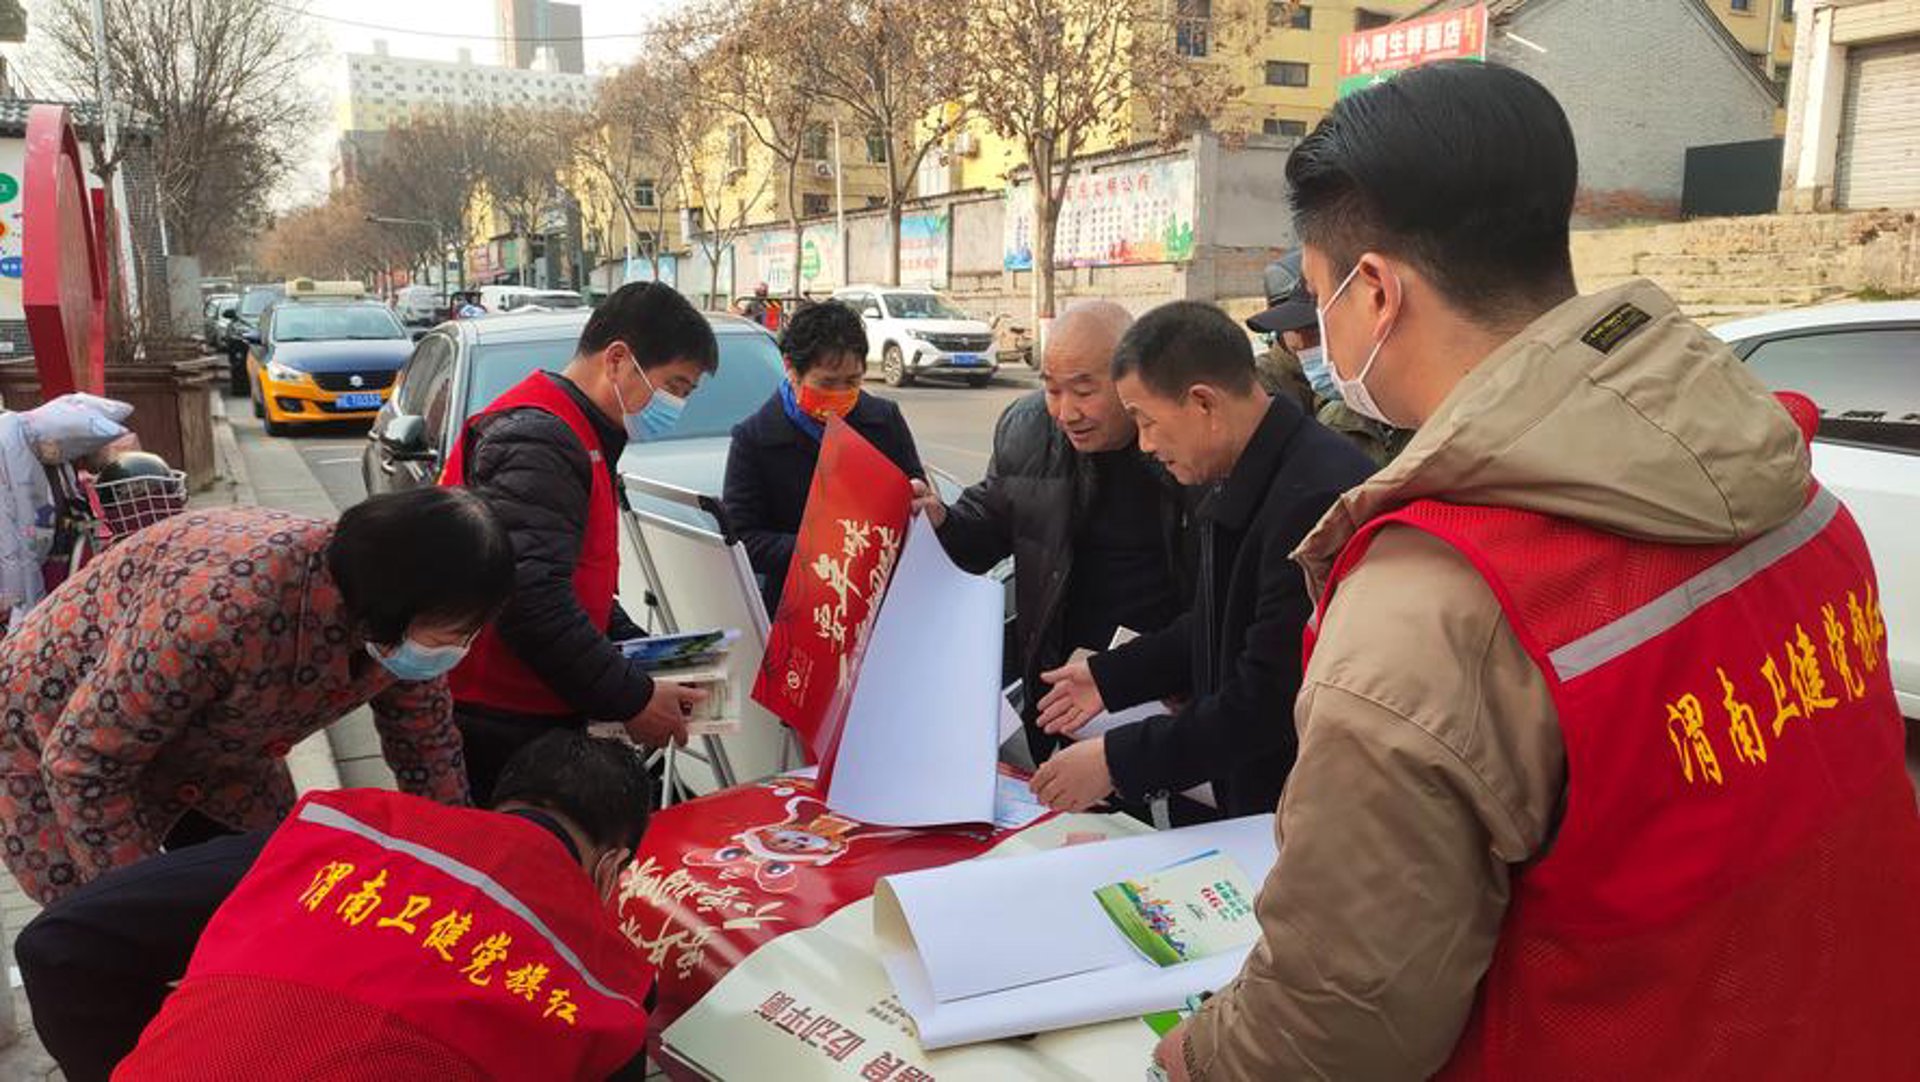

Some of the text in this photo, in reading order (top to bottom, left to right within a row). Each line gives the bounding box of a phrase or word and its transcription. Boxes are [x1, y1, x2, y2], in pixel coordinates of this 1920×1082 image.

[1666, 579, 1884, 784] 渭南卫健党旗红
[299, 861, 577, 1025] 渭南卫健党旗红
[753, 990, 866, 1063] 吃动平衡
